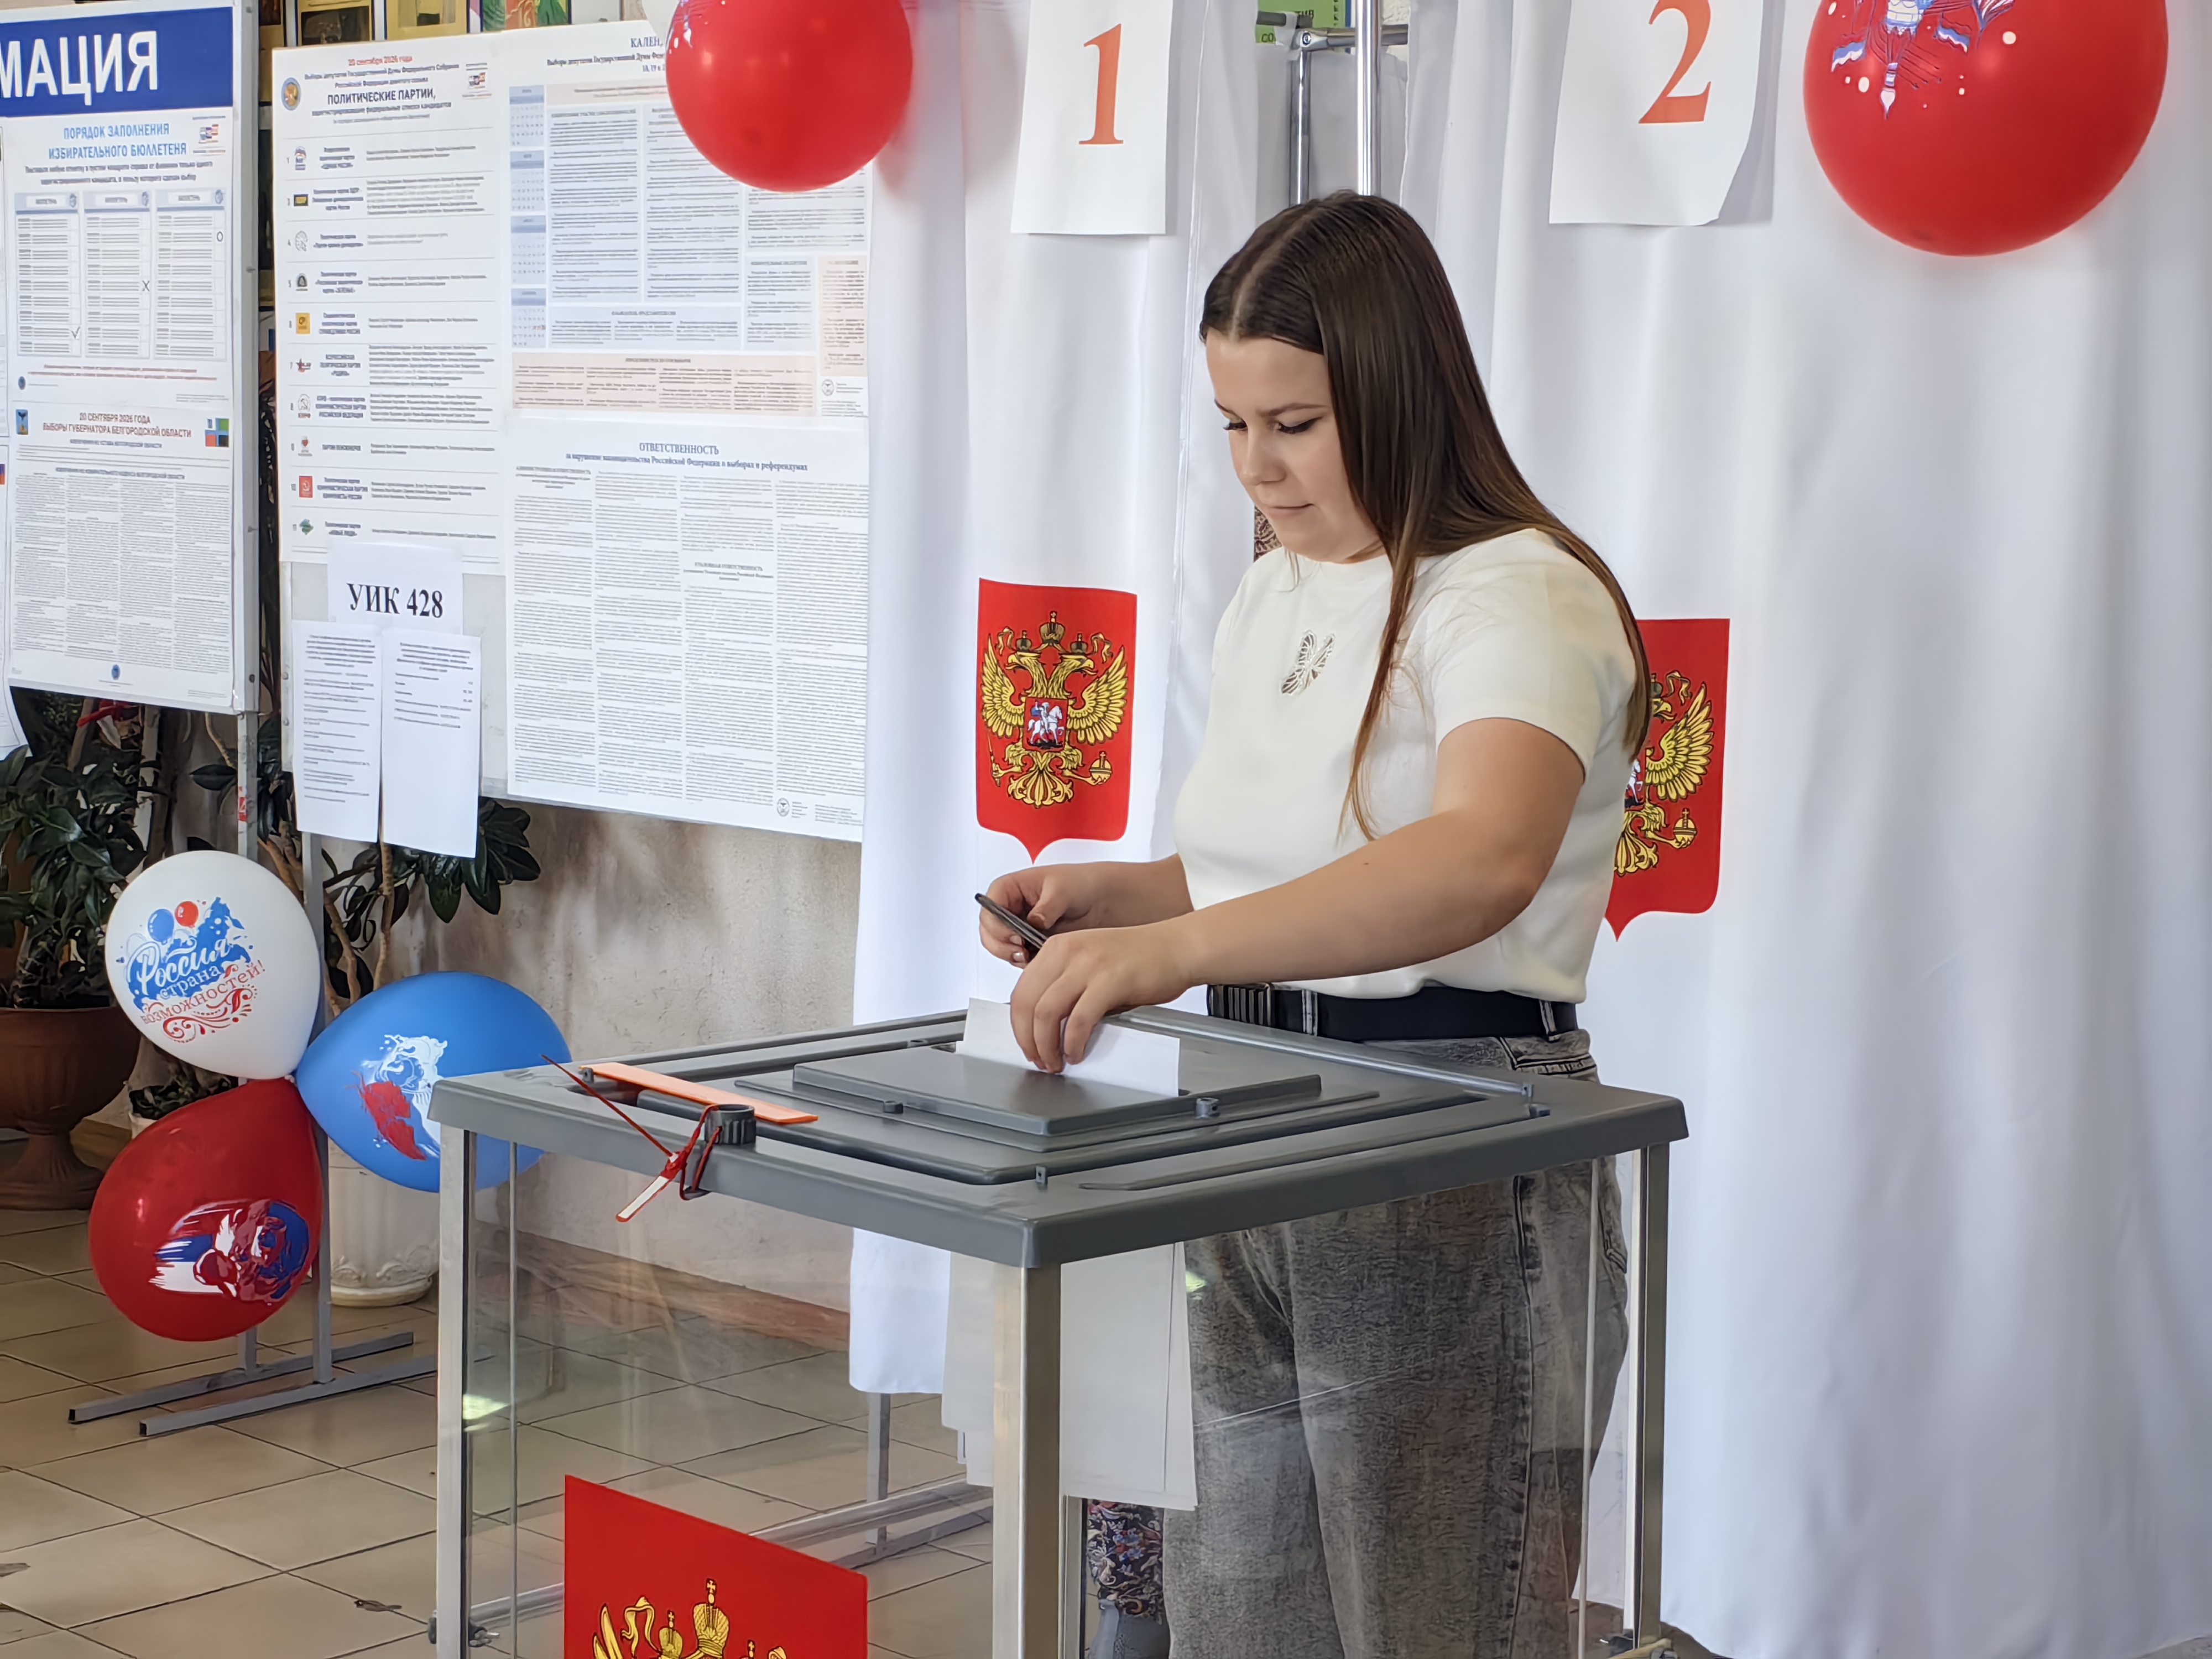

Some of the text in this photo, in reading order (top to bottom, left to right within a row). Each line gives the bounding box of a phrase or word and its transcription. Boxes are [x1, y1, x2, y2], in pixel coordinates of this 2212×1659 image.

[631, 36, 663, 48] КАЛЕН
[1639, 0, 1711, 123] 2
[327, 88, 436, 105] ПОЛИТИЧЕСКИЕ ПАРТИИ,
[1079, 23, 1123, 144] 1
[64, 123, 169, 140] ПОРЯДОК ЗАПОЛНЕНИЯ
[49, 143, 187, 159] ИЗБИРАТЕЛЬНОГО БЮЛЛЕТЕНЯ
[639, 442, 719, 455] ОТВЕТСТВЕННОСТЬ
[346, 583, 443, 618] УИК 428
[140, 960, 265, 1024] возможностей!
[160, 965, 222, 1000] страна
